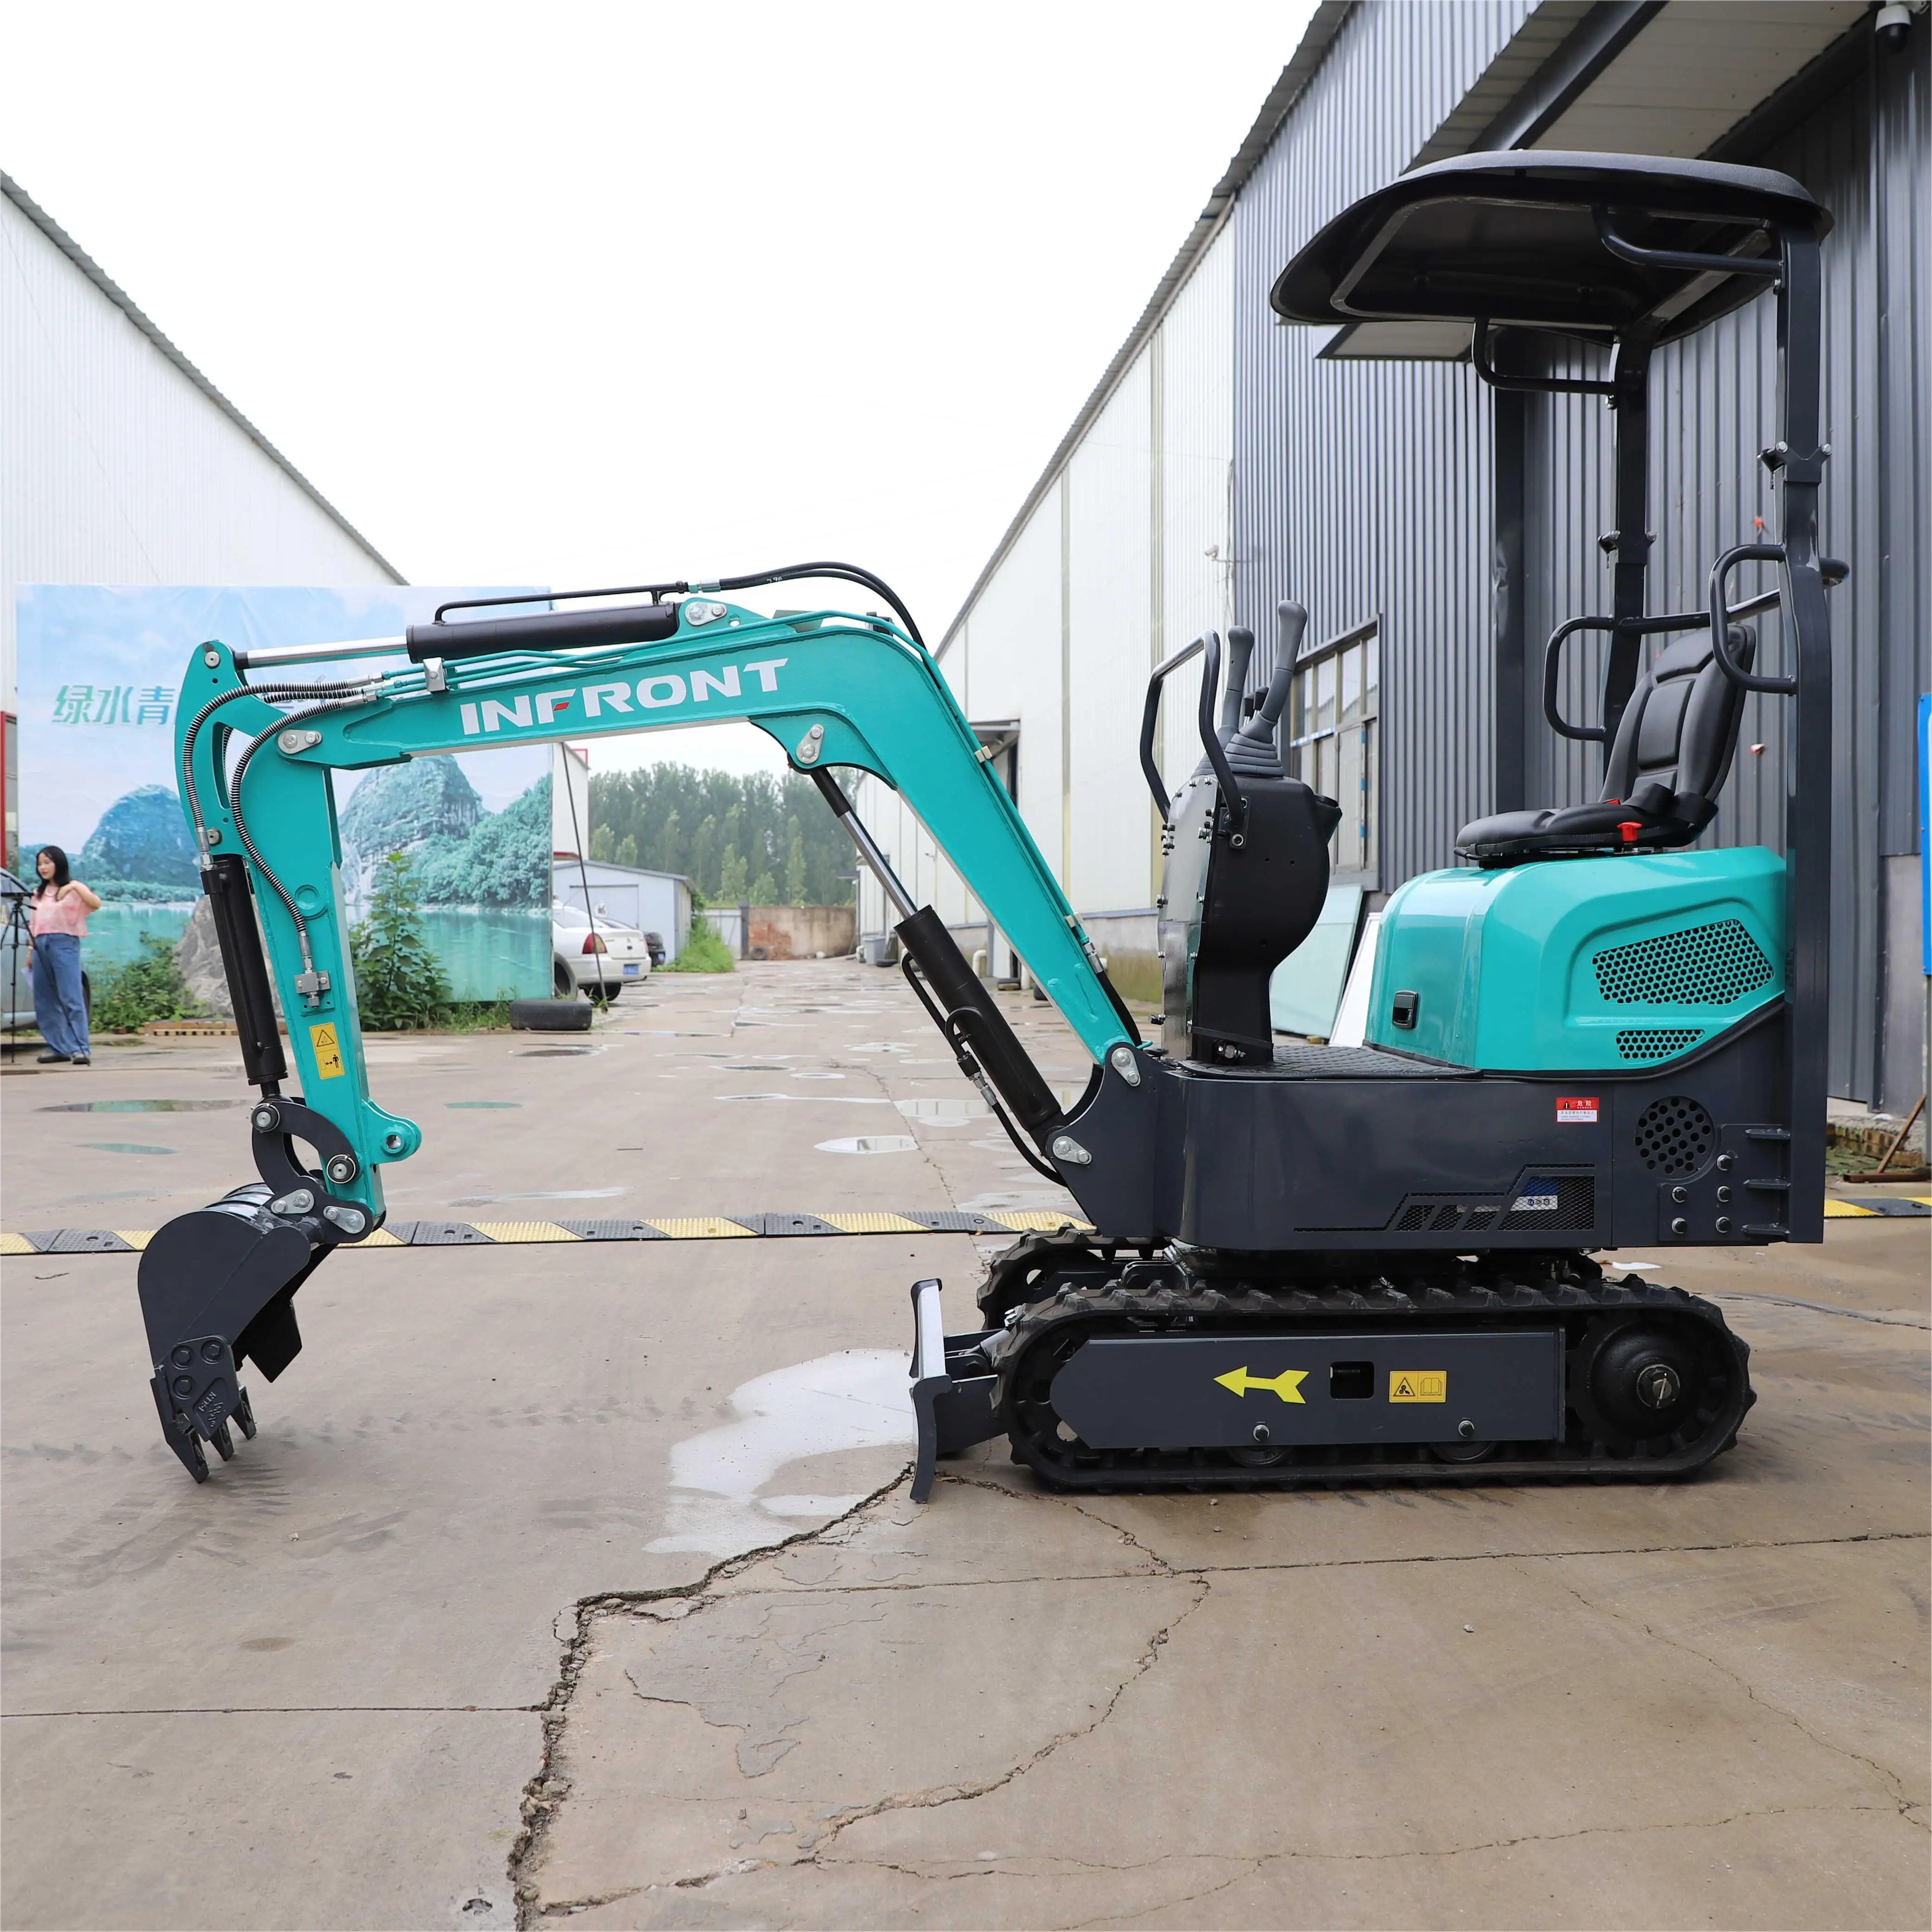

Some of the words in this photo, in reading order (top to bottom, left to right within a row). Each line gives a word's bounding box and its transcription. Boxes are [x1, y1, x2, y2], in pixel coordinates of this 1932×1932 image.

[52, 685, 176, 725] 绿水青
[460, 658, 788, 735] INFRONT
